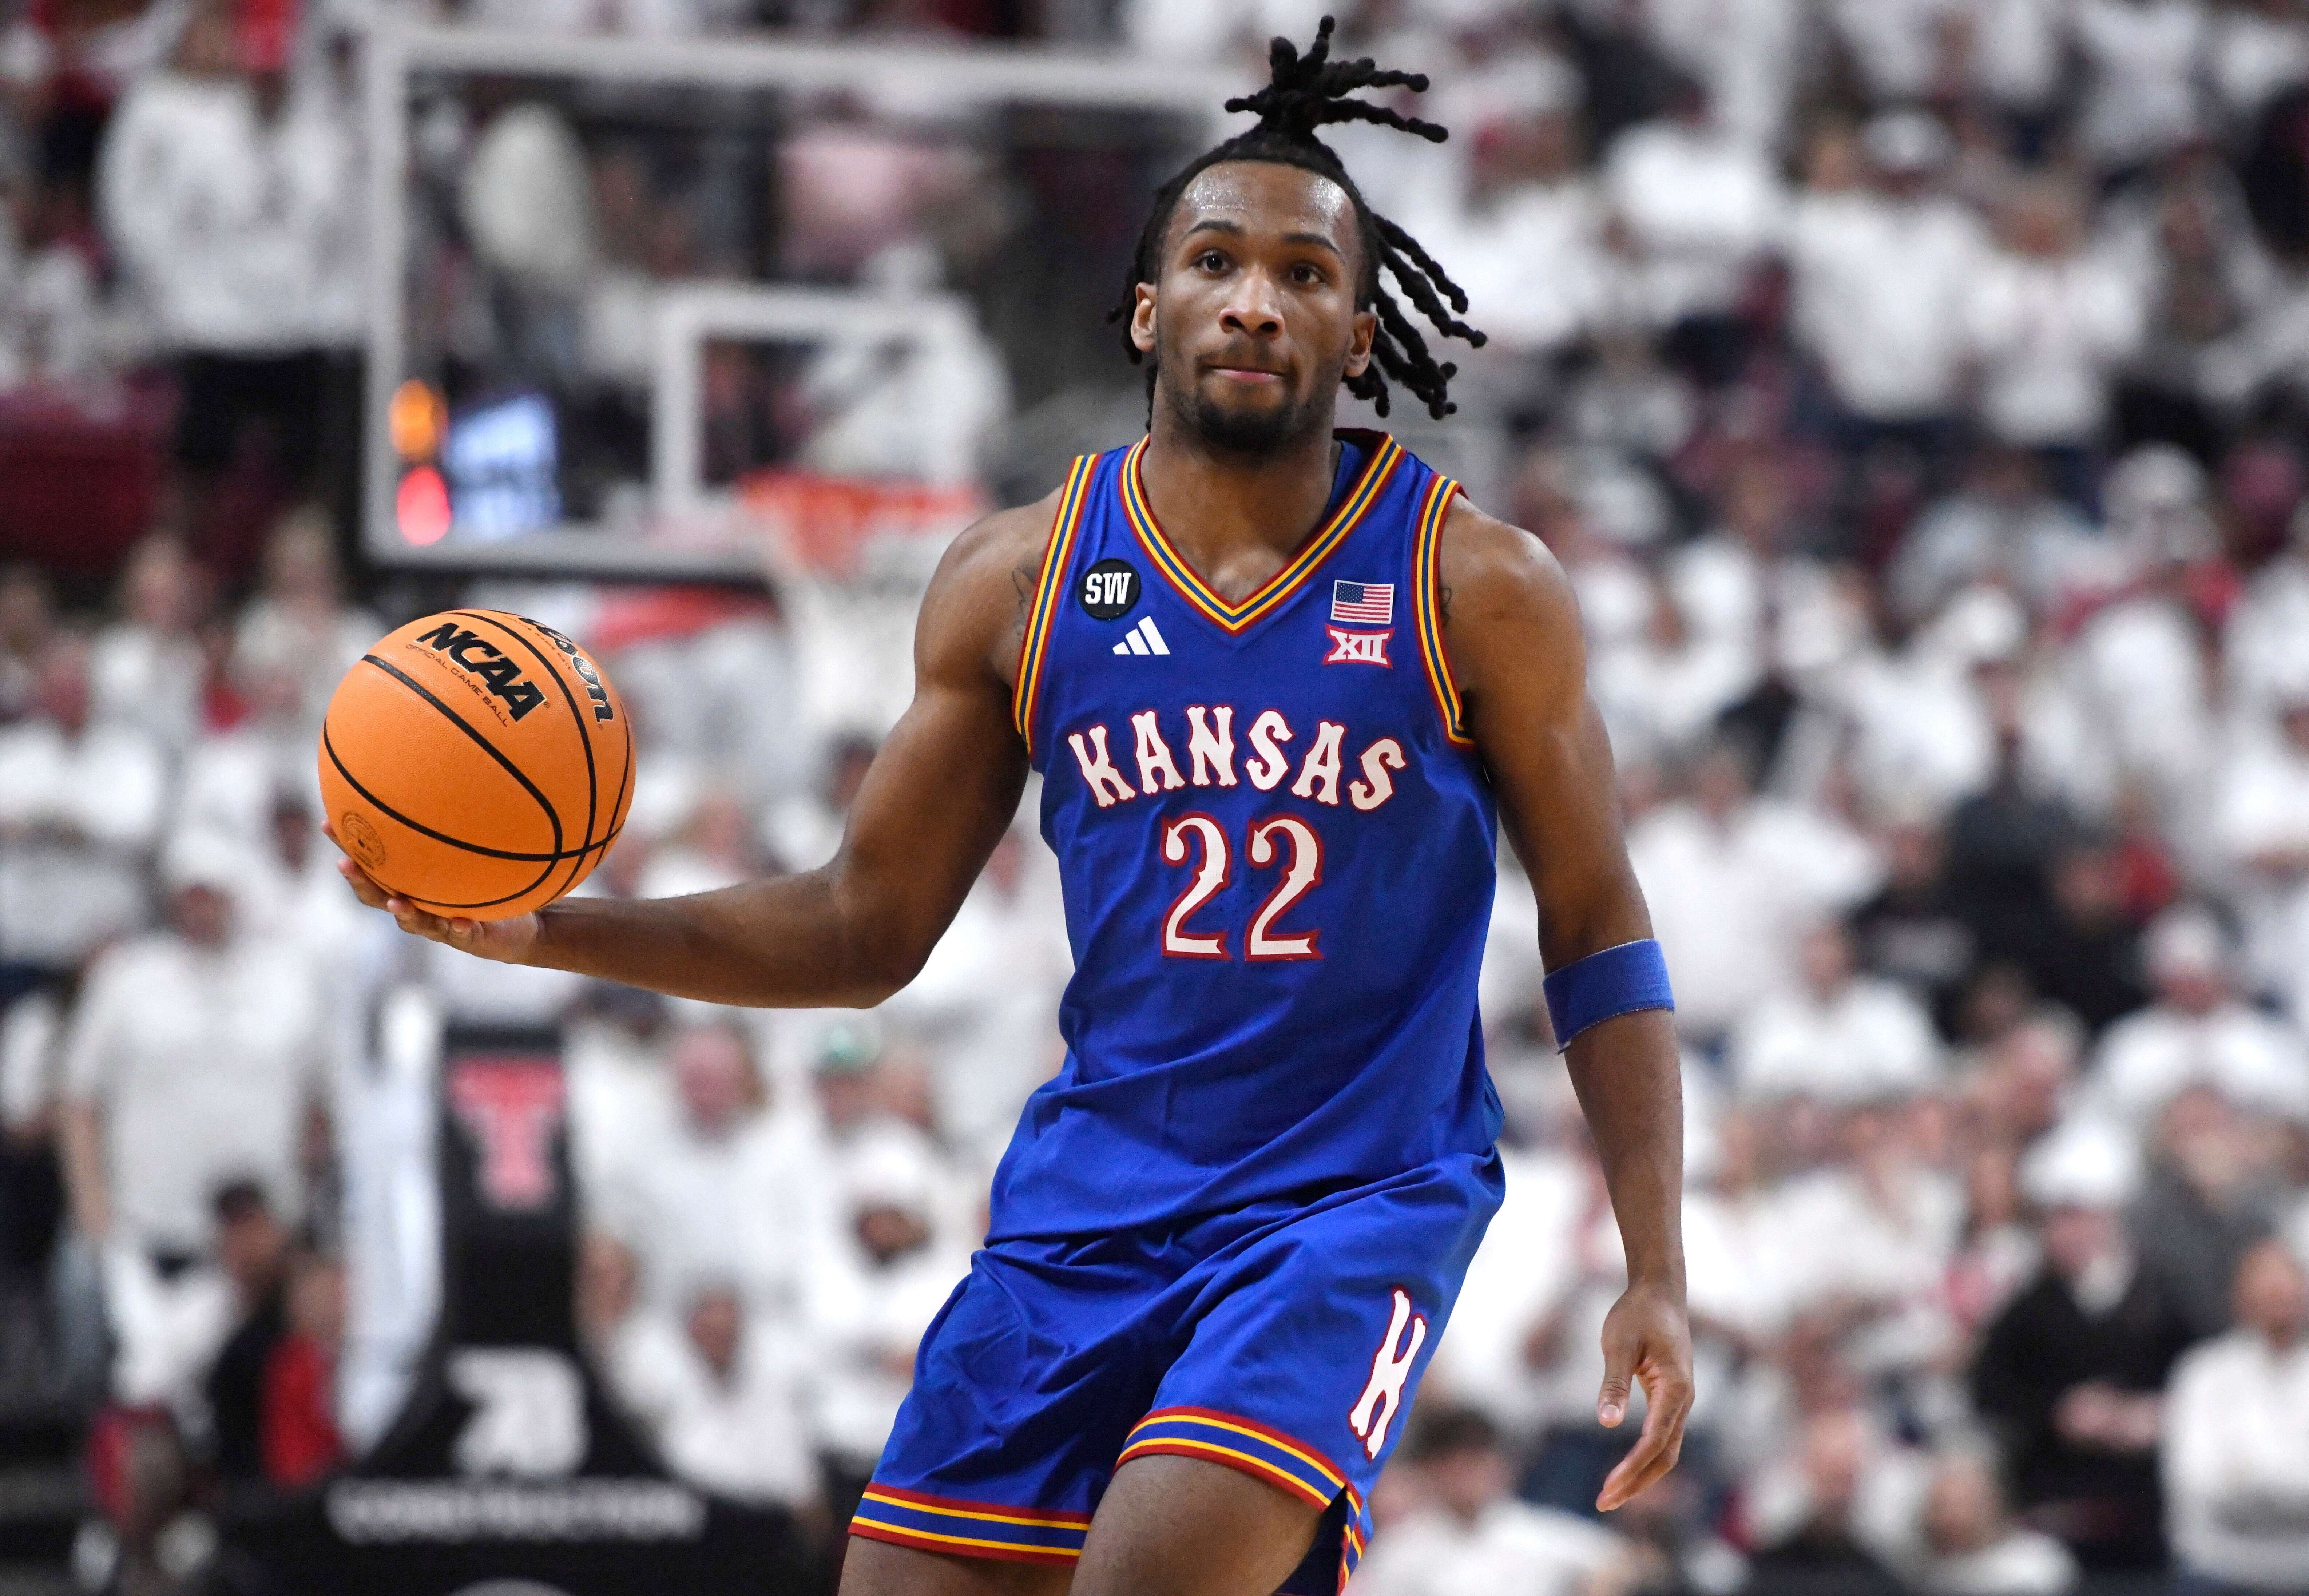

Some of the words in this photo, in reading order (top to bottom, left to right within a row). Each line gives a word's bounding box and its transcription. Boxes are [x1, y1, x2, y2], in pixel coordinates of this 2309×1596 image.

[1085, 572, 1132, 604] SW
[406, 644, 448, 670] OFFICIAL
[451, 668, 483, 696] GAME
[482, 696, 508, 728] BALL
[414, 622, 547, 724] NCAA
[1326, 628, 1391, 666] XII
[1068, 704, 1408, 811] KANSAS
[1159, 811, 1324, 961] 22
